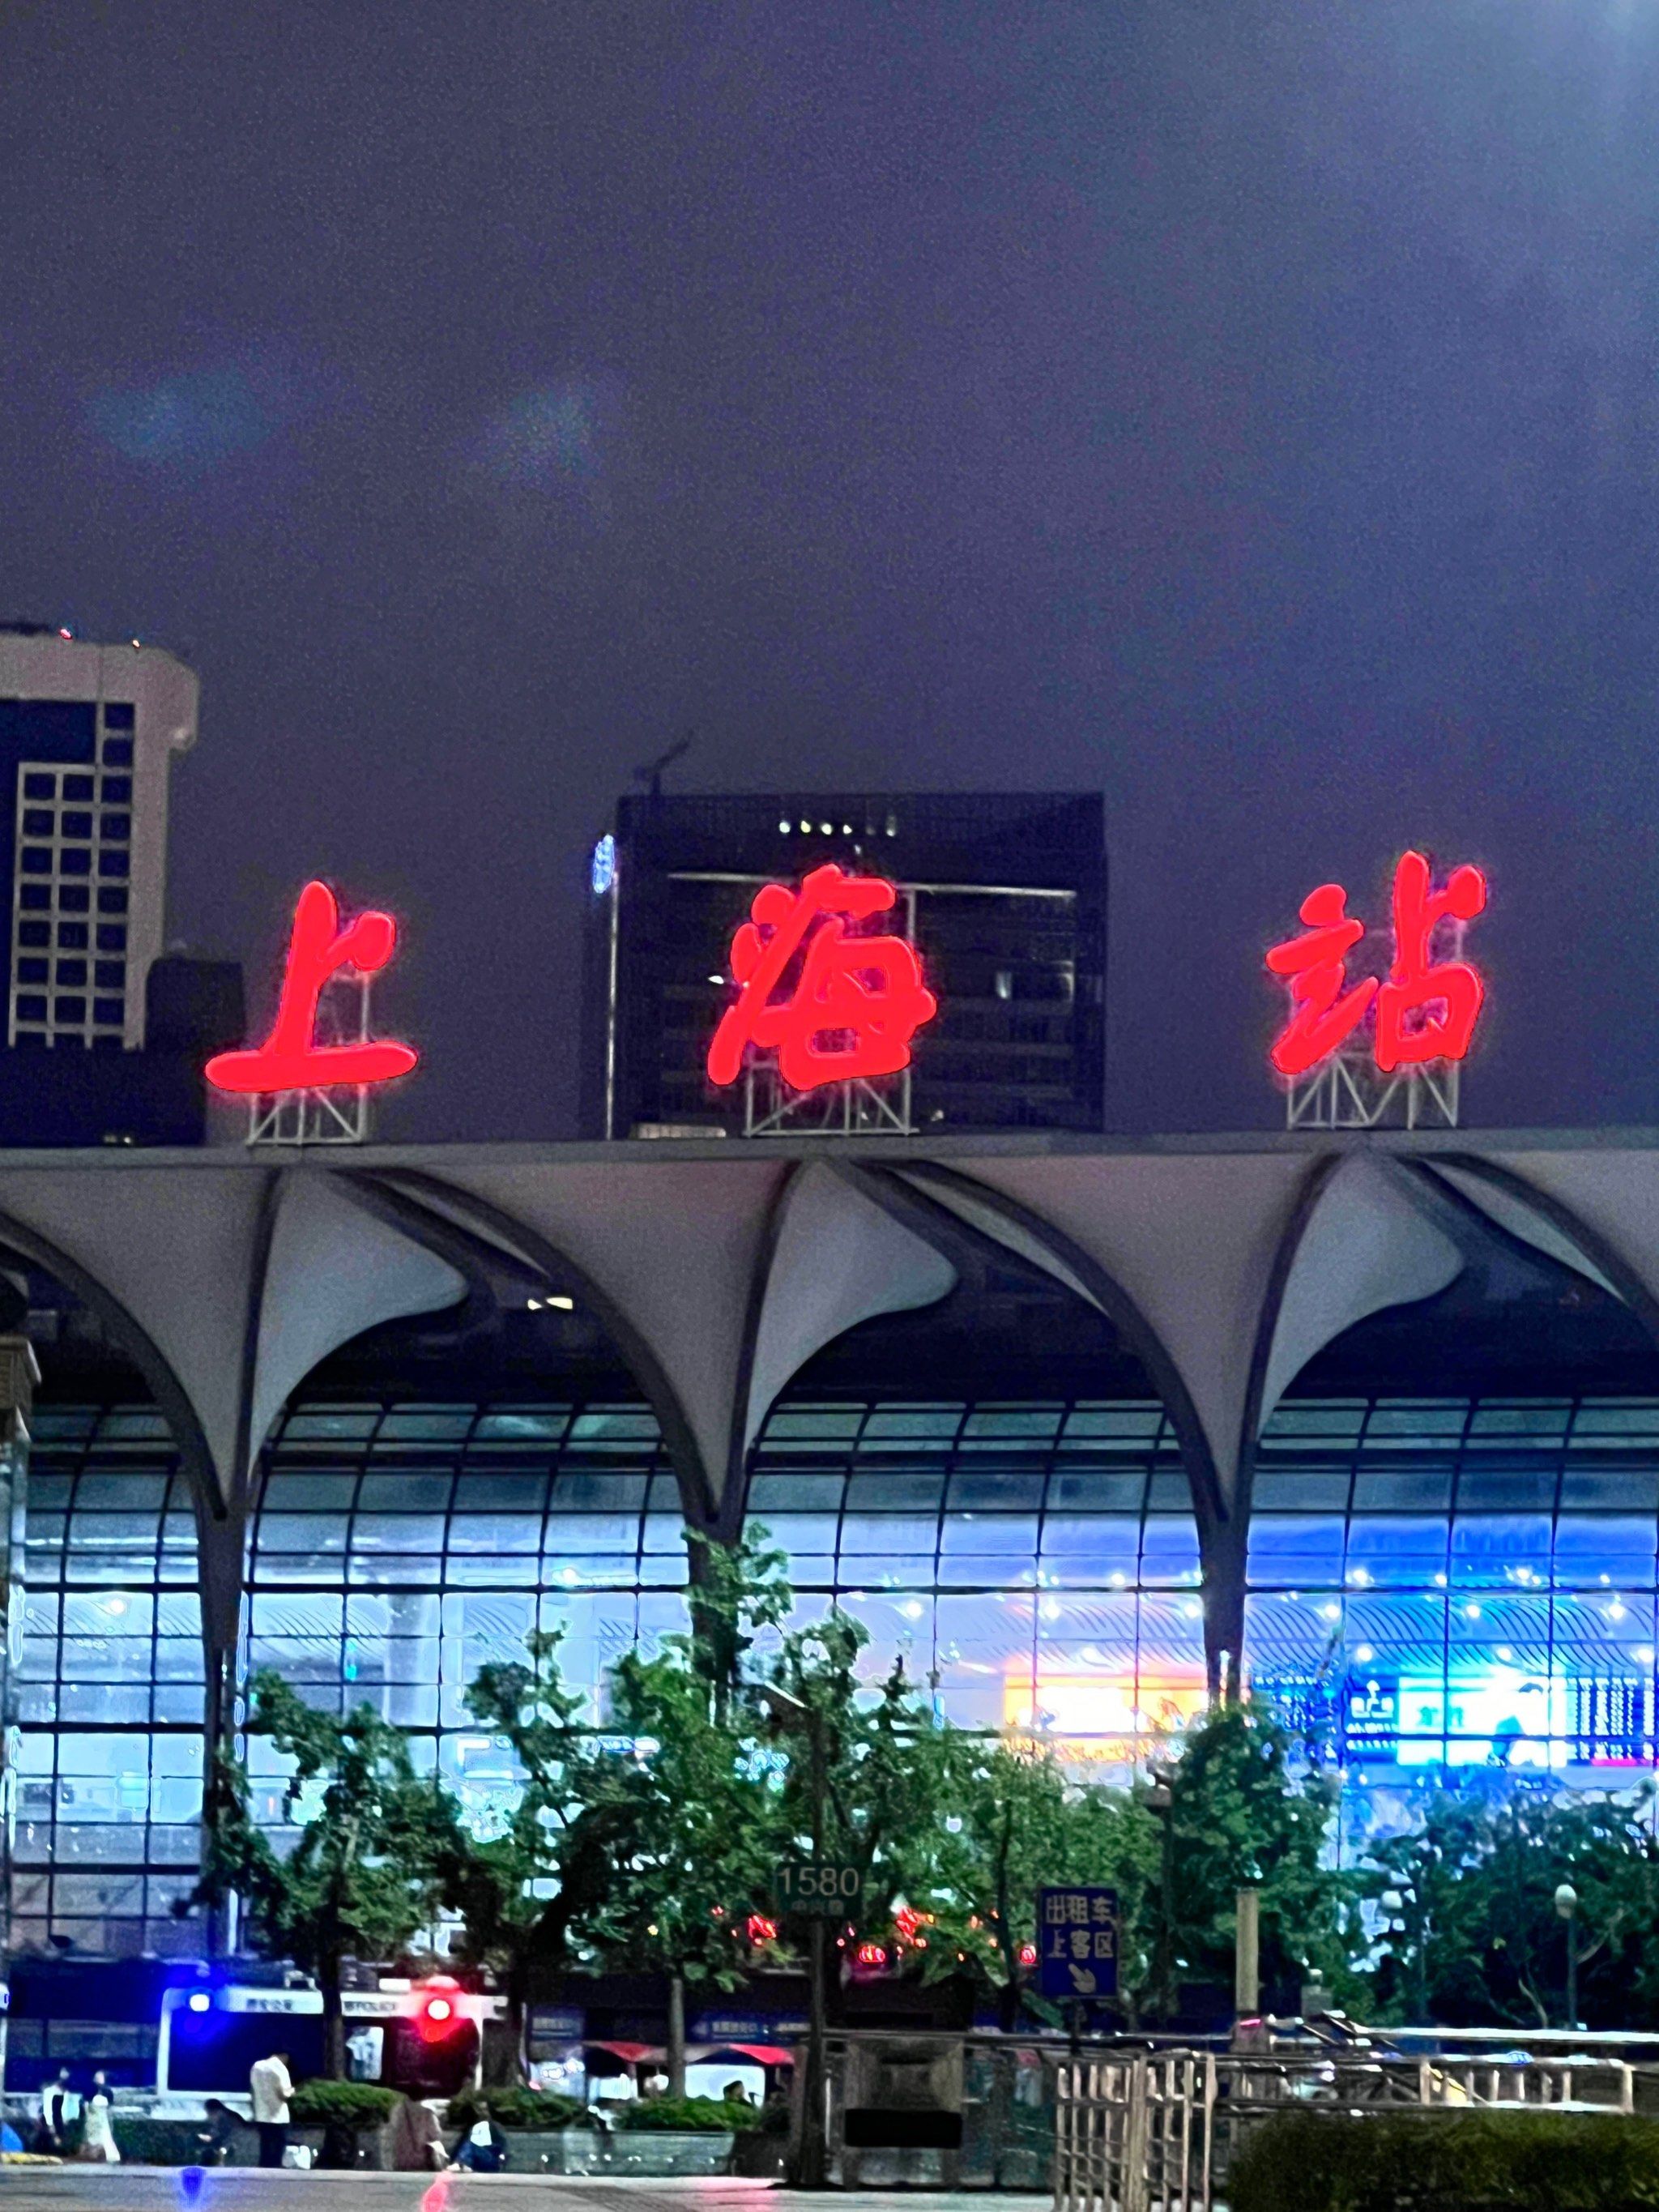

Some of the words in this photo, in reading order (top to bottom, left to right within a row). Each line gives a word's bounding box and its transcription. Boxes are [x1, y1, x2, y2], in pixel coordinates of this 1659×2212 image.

[205, 851, 1487, 1093] 上海站
[778, 1867, 859, 1896] 1580
[1046, 1894, 1115, 1924] 出租车
[1047, 1928, 1114, 1959] 上客区
